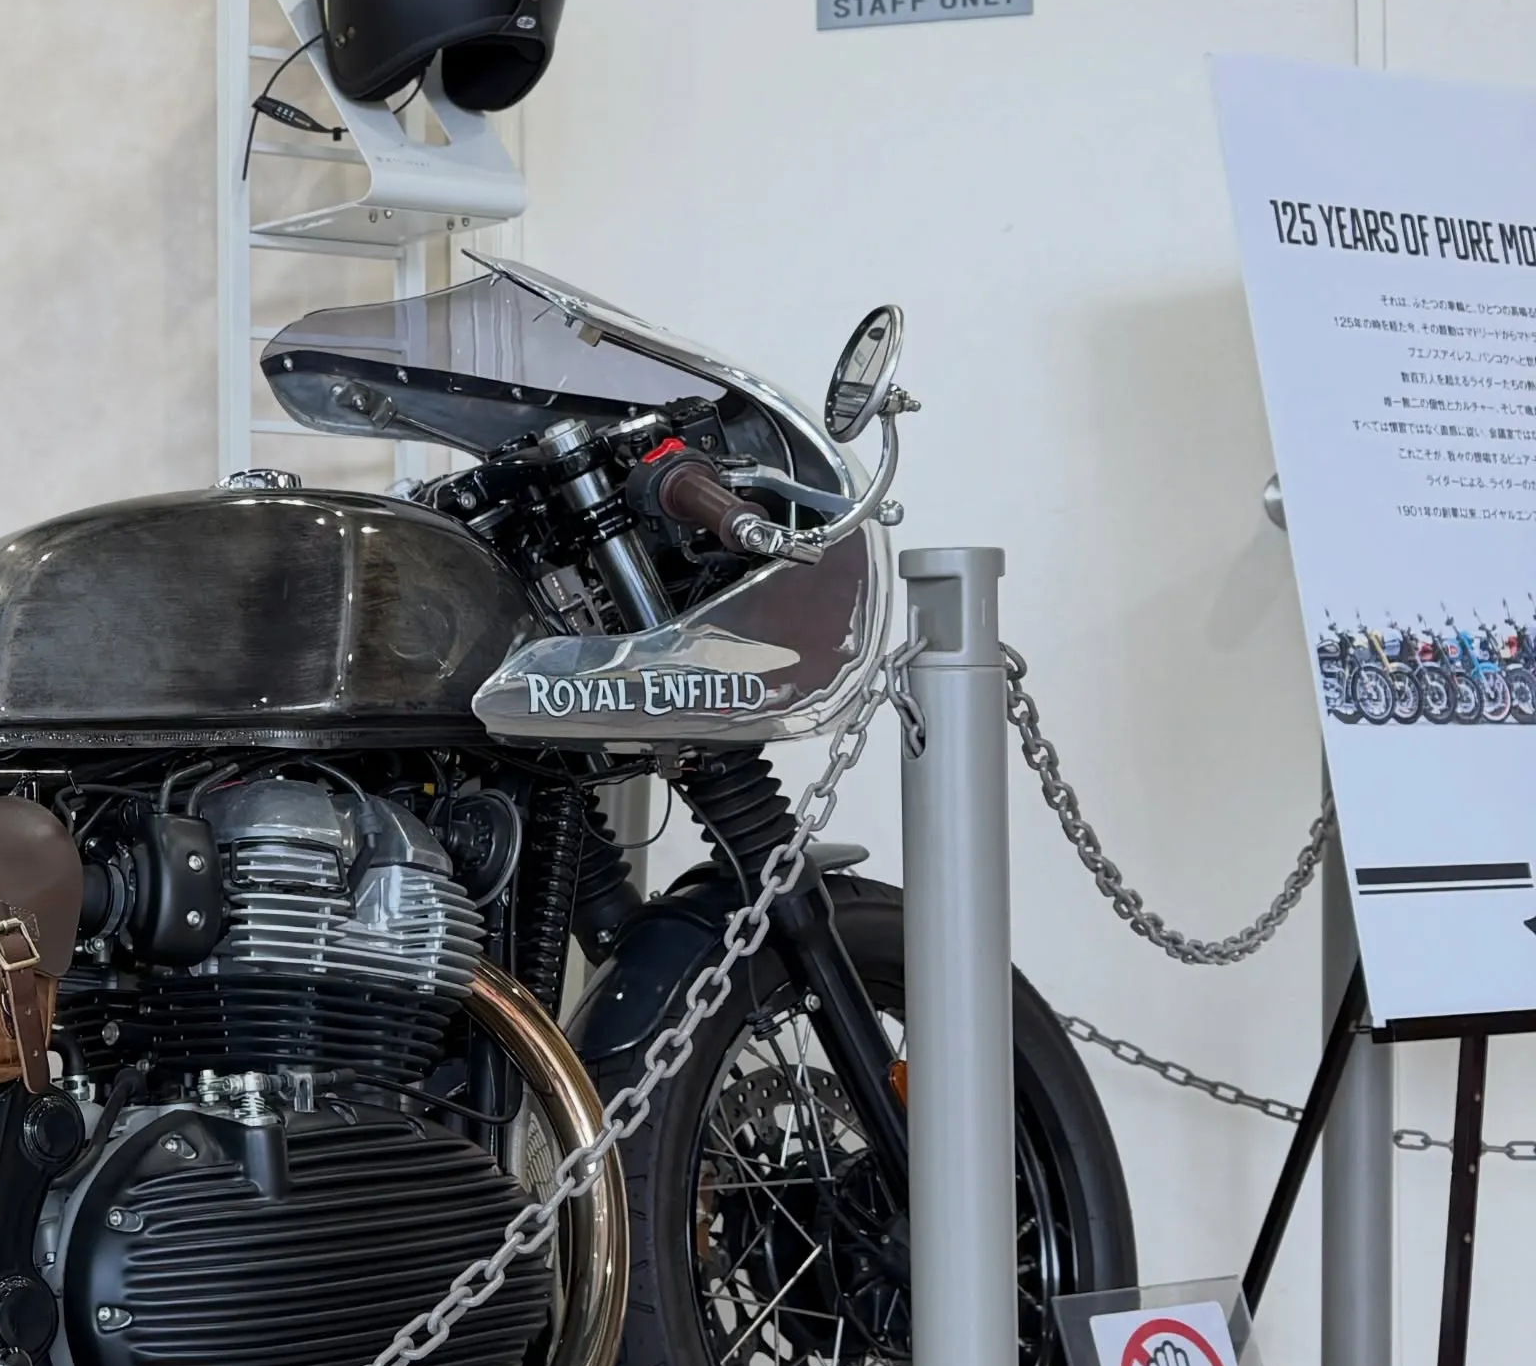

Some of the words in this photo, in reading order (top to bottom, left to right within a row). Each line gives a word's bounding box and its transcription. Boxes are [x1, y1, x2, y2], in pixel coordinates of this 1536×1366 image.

[1269, 198, 1318, 246] 125
[1318, 203, 1399, 254] YEARS
[1401, 211, 1434, 258] OF
[1435, 215, 1500, 264] PURE
[1498, 223, 1536, 267] MO
[526, 671, 635, 718] ROYAL
[642, 669, 767, 716] ENFIELD
